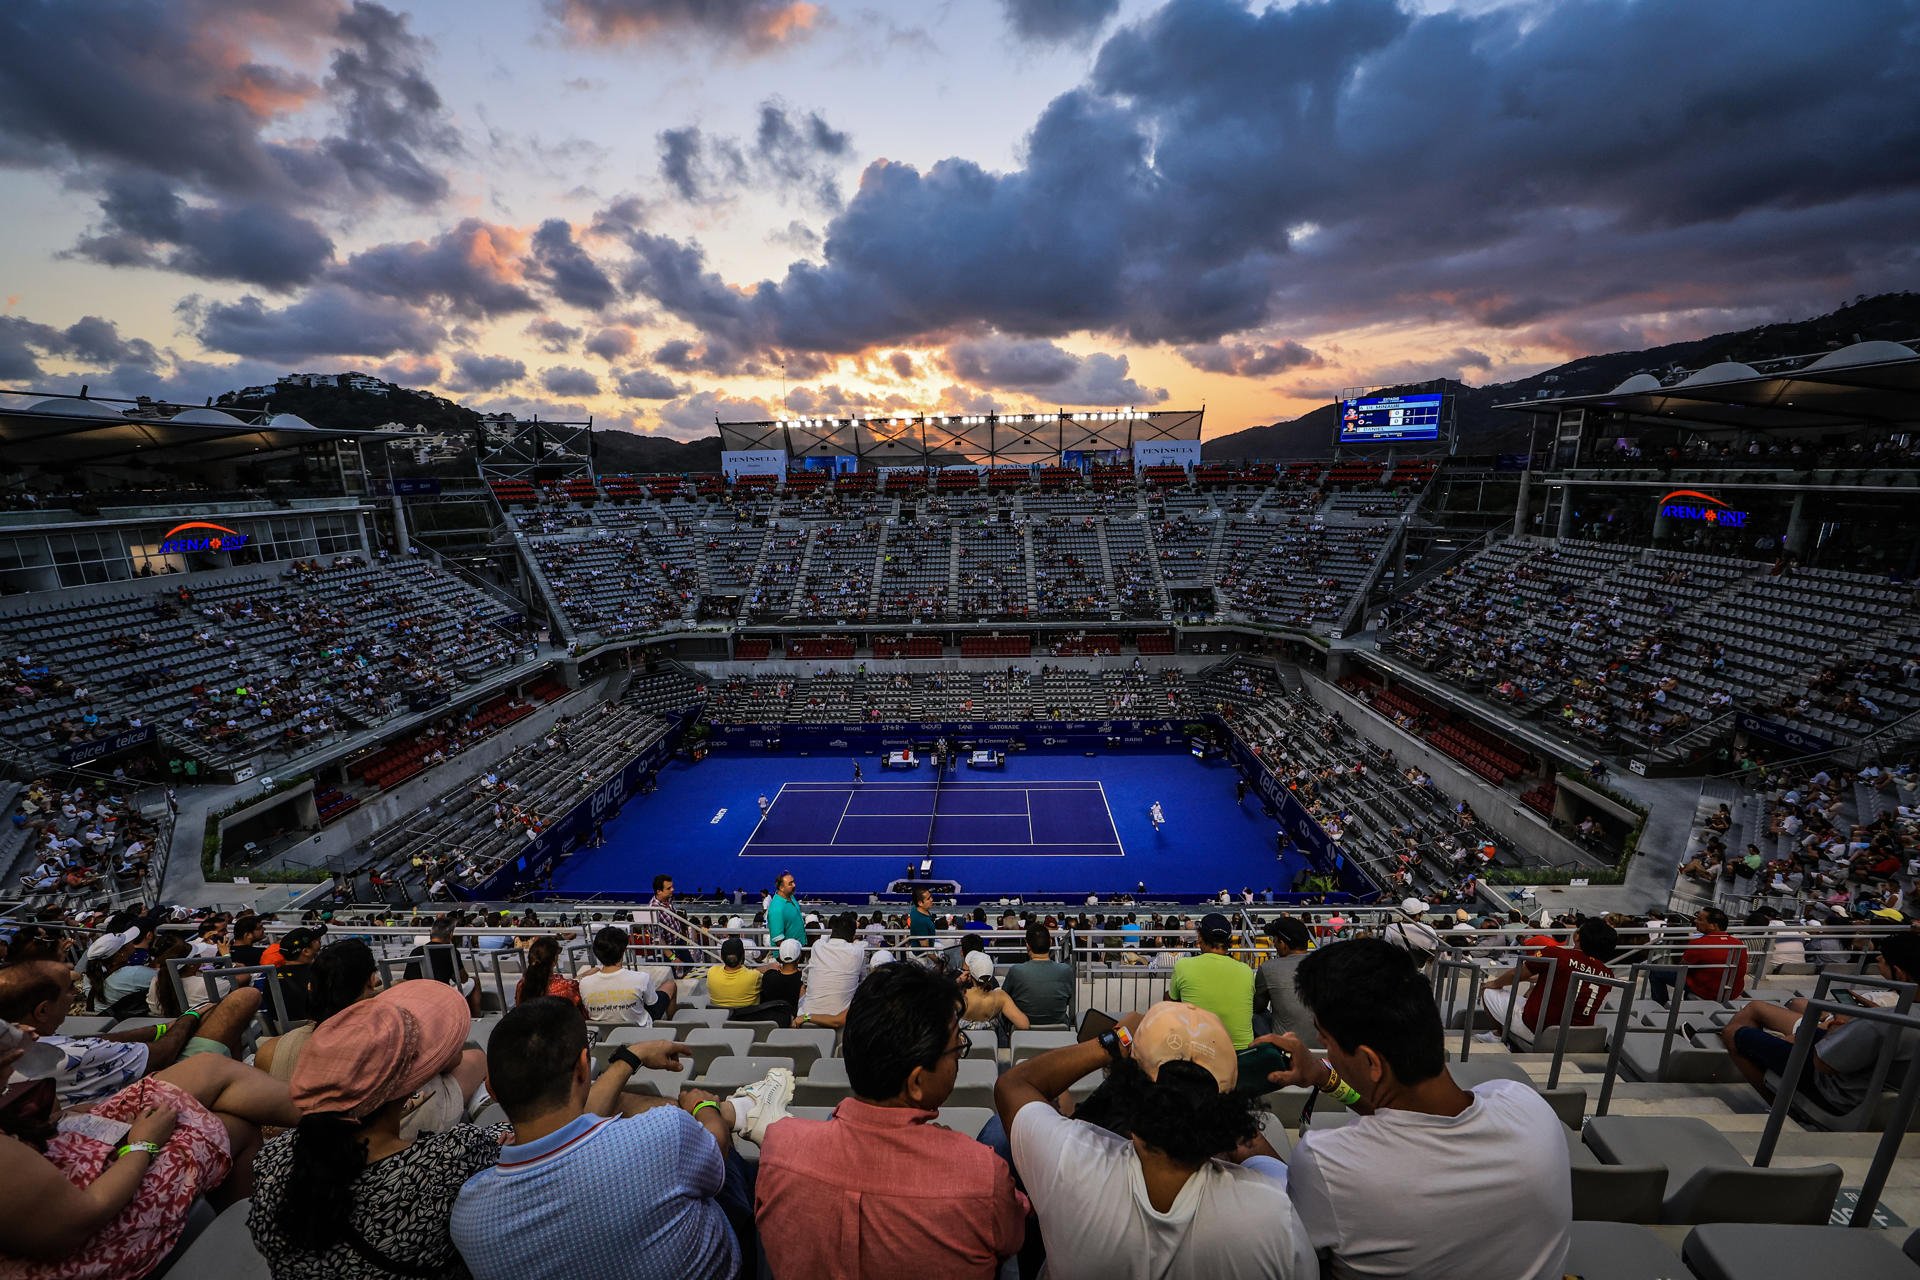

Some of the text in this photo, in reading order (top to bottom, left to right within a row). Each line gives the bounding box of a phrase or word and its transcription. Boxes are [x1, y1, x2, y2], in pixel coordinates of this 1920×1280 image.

[1661, 505, 1746, 523] ARENA GNP
[158, 534, 248, 554] ARENA GNP
[114, 727, 149, 748] telcel
[69, 742, 107, 762] telcel
[591, 769, 625, 818] telcel
[1260, 769, 1288, 811] telcel
